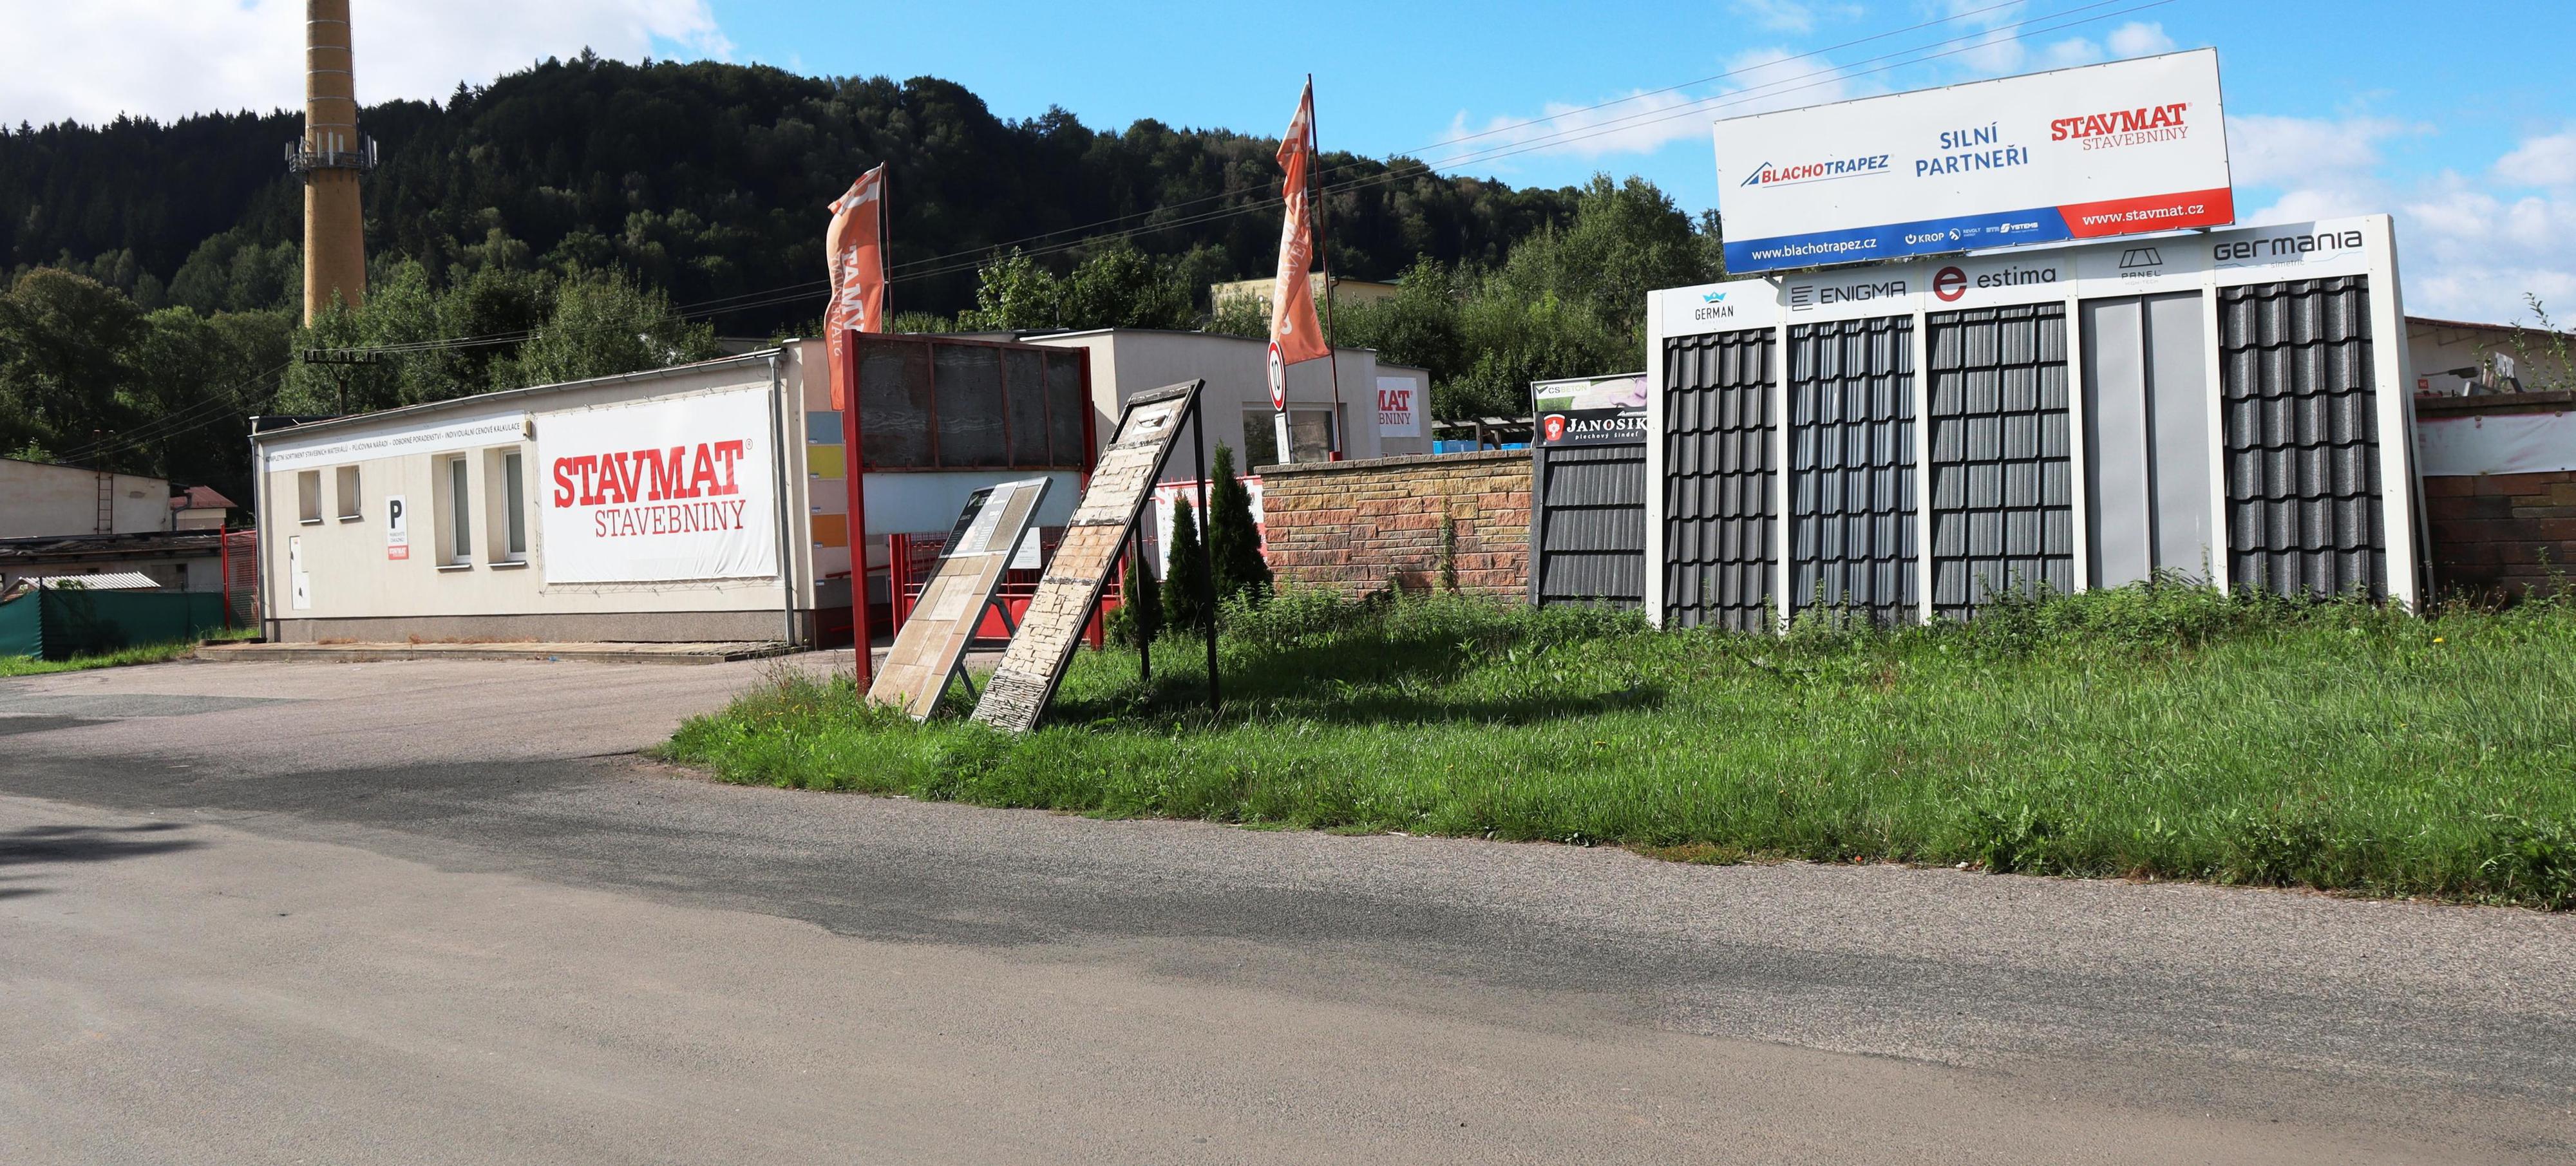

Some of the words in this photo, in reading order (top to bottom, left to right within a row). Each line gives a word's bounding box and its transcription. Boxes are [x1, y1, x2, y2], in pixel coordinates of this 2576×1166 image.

[2050, 103, 2186, 141] STAVMAT
[1940, 121, 1998, 149] SILNÍ
[2083, 126, 2188, 151] STAVEBNINY
[1762, 155, 1889, 183] BLACHOTRAPEZ
[1916, 144, 2028, 177] PARTNEŘI
[2082, 204, 2204, 225] www.stavmat.cz
[1752, 238, 1877, 260] www.blachotrapez.cz
[1918, 232, 1945, 243] KROP
[1976, 266, 2056, 288] estima
[2121, 270, 2161, 279] PANEL
[1820, 281, 1906, 305] ENIGMA
[1695, 305, 1734, 320] GERMAN
[1271, 359, 1280, 391] 10
[494, 422, 520, 433] KALKULACE
[1566, 418, 1647, 432] JANOSIK
[553, 439, 744, 508] STAVMAT
[390, 500, 402, 529] P
[596, 500, 746, 538] STAVEBNINY
